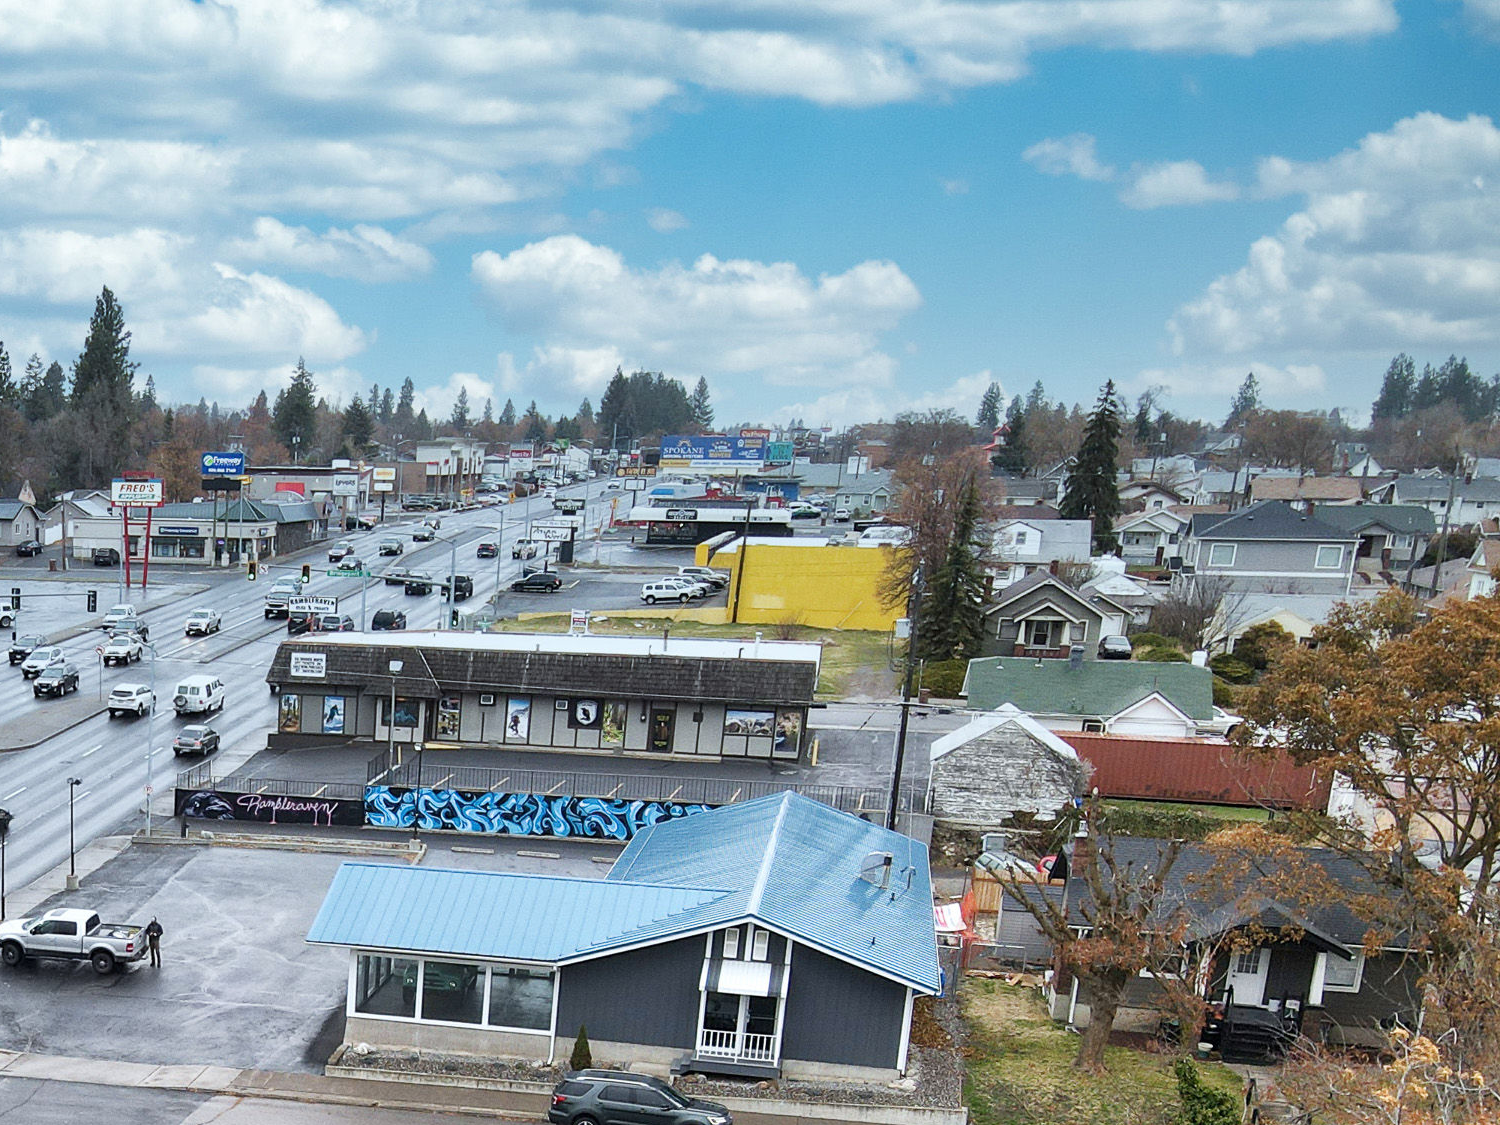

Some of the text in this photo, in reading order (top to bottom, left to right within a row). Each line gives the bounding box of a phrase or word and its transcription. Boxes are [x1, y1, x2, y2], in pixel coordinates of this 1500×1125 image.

[662, 446, 705, 454] SPOKANE
[120, 484, 155, 493] FRED'S
[237, 794, 339, 821] Rambleraven
